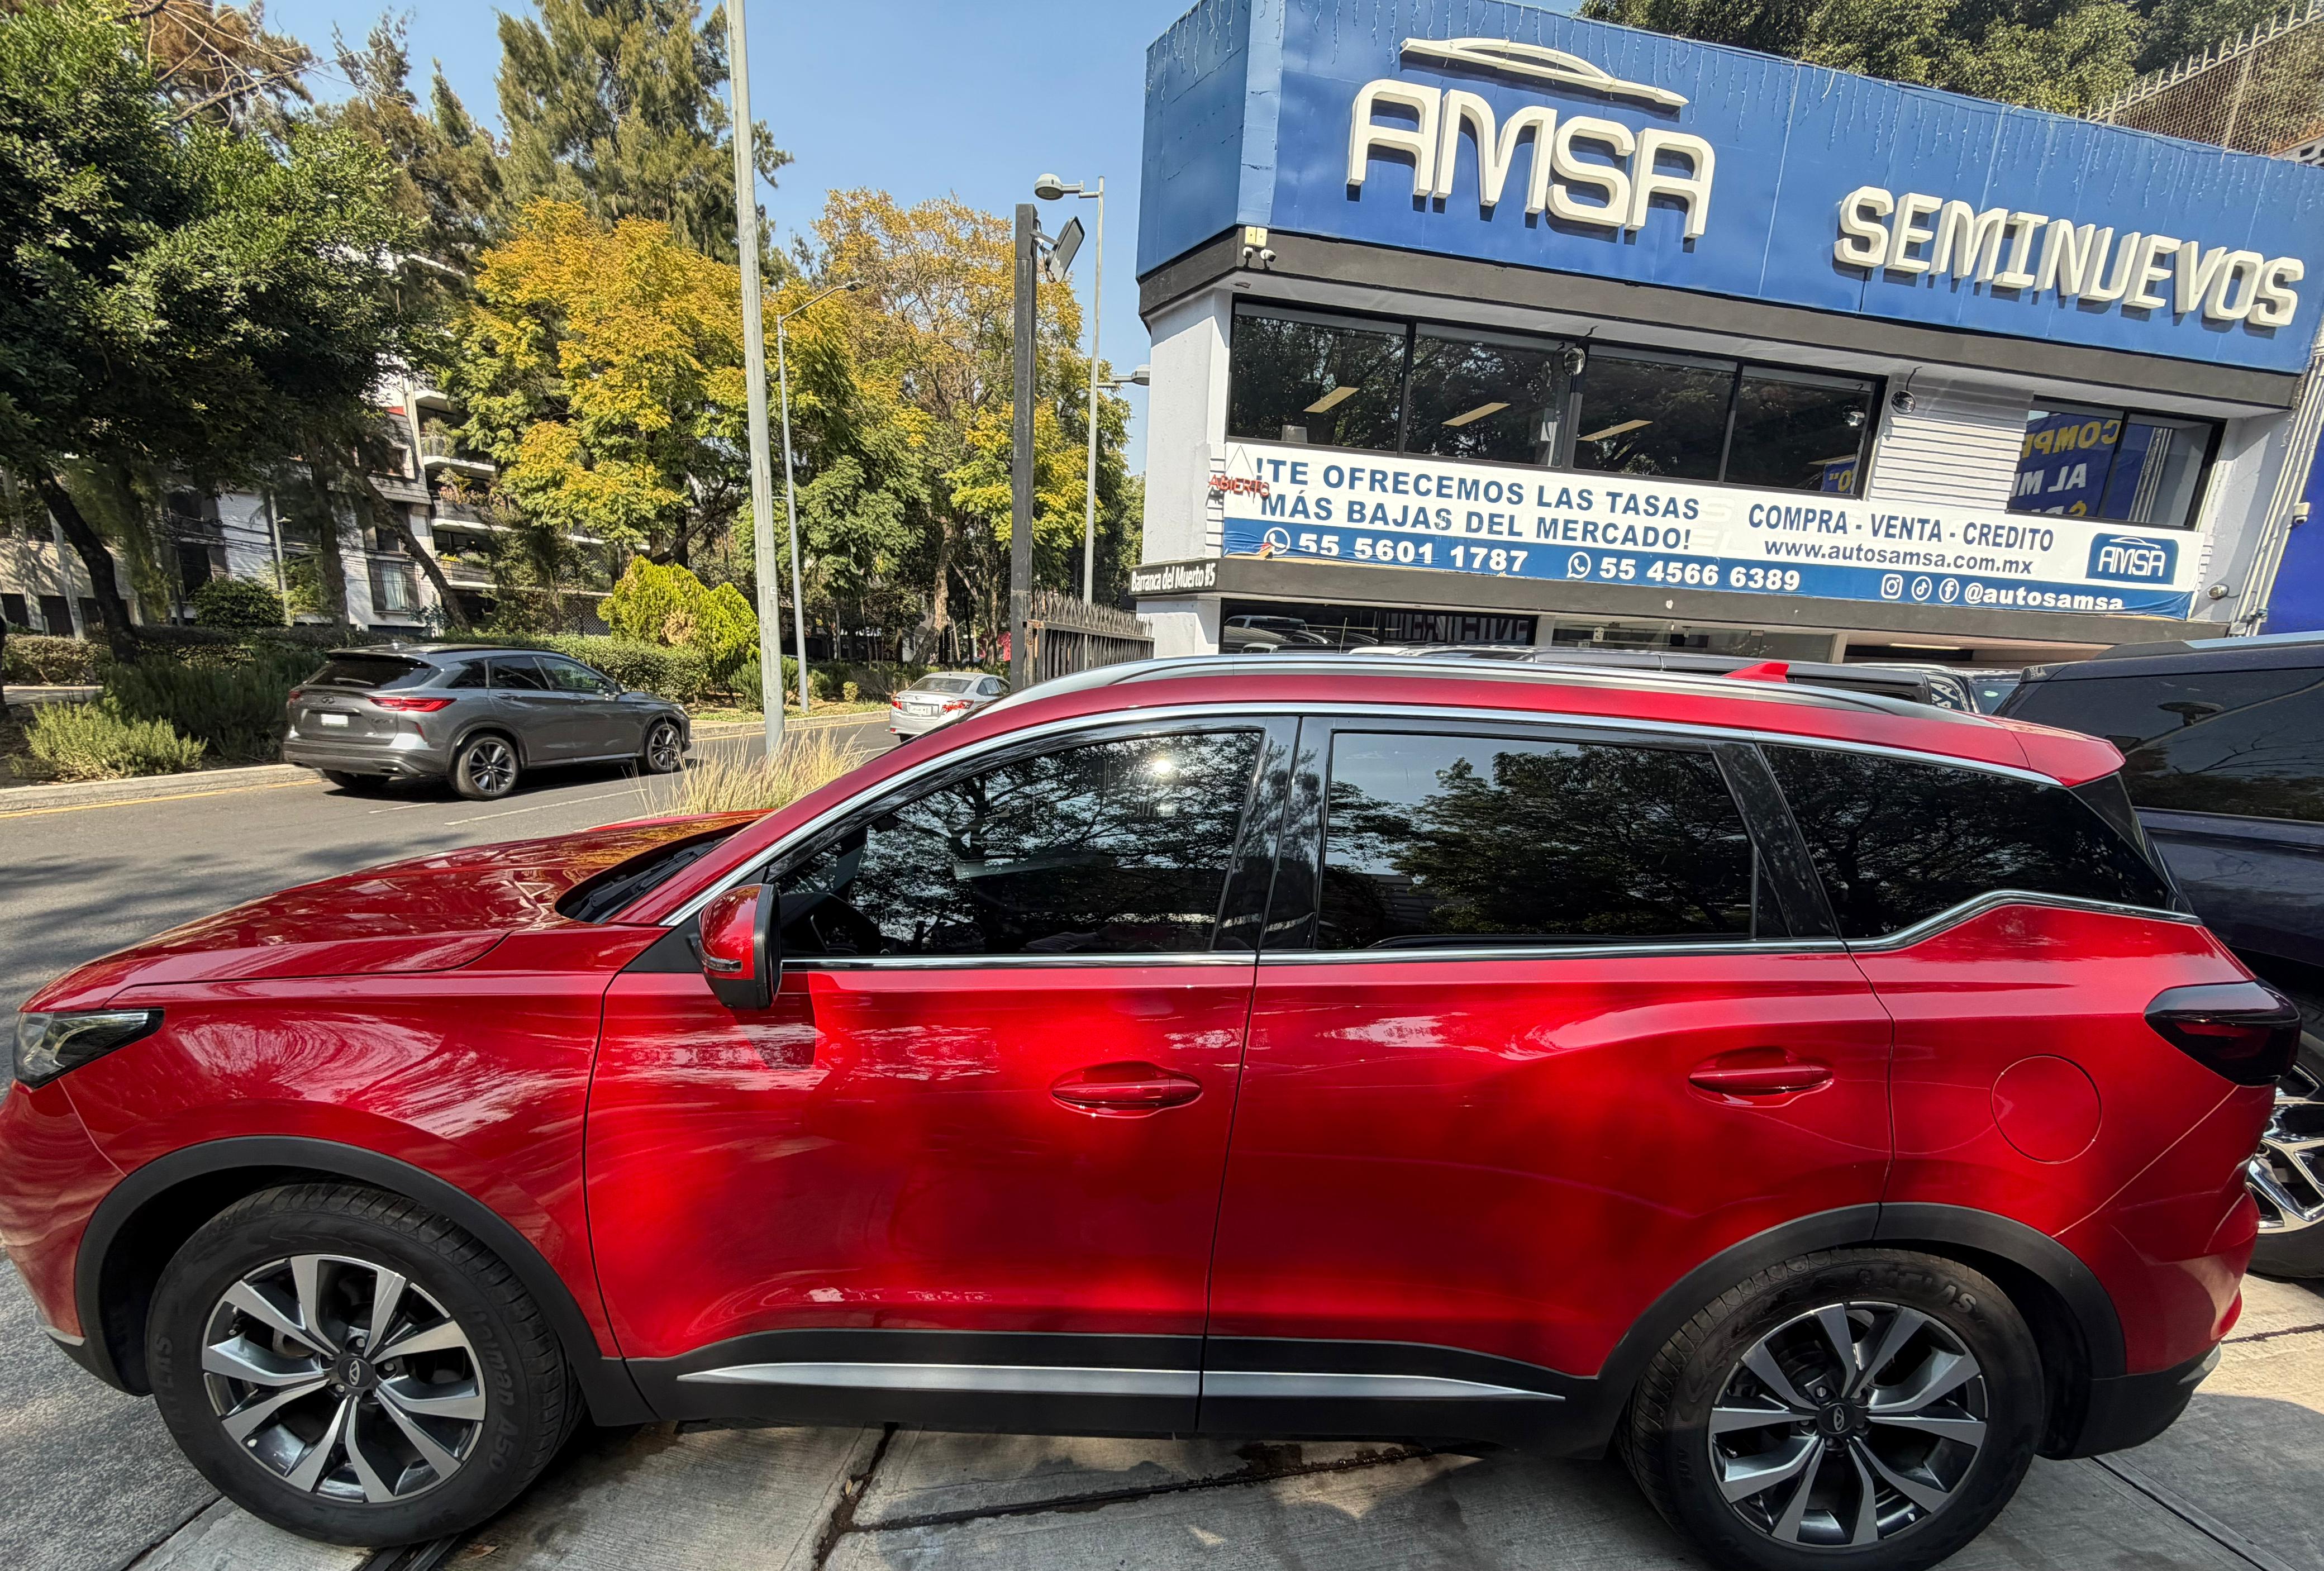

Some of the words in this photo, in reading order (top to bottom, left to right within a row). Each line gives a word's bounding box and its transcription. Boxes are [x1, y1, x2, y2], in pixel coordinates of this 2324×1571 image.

[1347, 79, 1715, 239] AMSA
[1834, 185, 2304, 327] SEMINUEVOS
[1208, 474, 1270, 497] ABIERTO
[1323, 465, 1524, 504] OFRECEMOS
[1537, 485, 1593, 511] LAS
[1606, 491, 1699, 520] TASAS
[1261, 490, 1333, 521] MÁS
[1347, 500, 1452, 531] BAJAS
[1465, 511, 1523, 537] DEL
[1536, 517, 1691, 550] MERCADO!
[1749, 503, 1847, 535] COMPRA
[1871, 513, 1942, 542] VENTA
[1963, 521, 2054, 551] CREDITO
[1299, 532, 1340, 556] 55
[1354, 537, 1433, 564] 5601
[1450, 545, 1528, 572] 1787
[1764, 540, 2034, 574] www.autosamsa.com.mx
[2098, 546, 2166, 577] AMSA
[1131, 571, 1161, 592] Barranca
[1162, 566, 1175, 590] del
[1175, 565, 1204, 589] Muerto
[1204, 563, 1216, 587] #5
[1599, 557, 1636, 580] 55
[1646, 560, 1719, 585] 4566
[1730, 566, 1801, 591] 6389
[1964, 582, 2125, 610] @autosamsa
